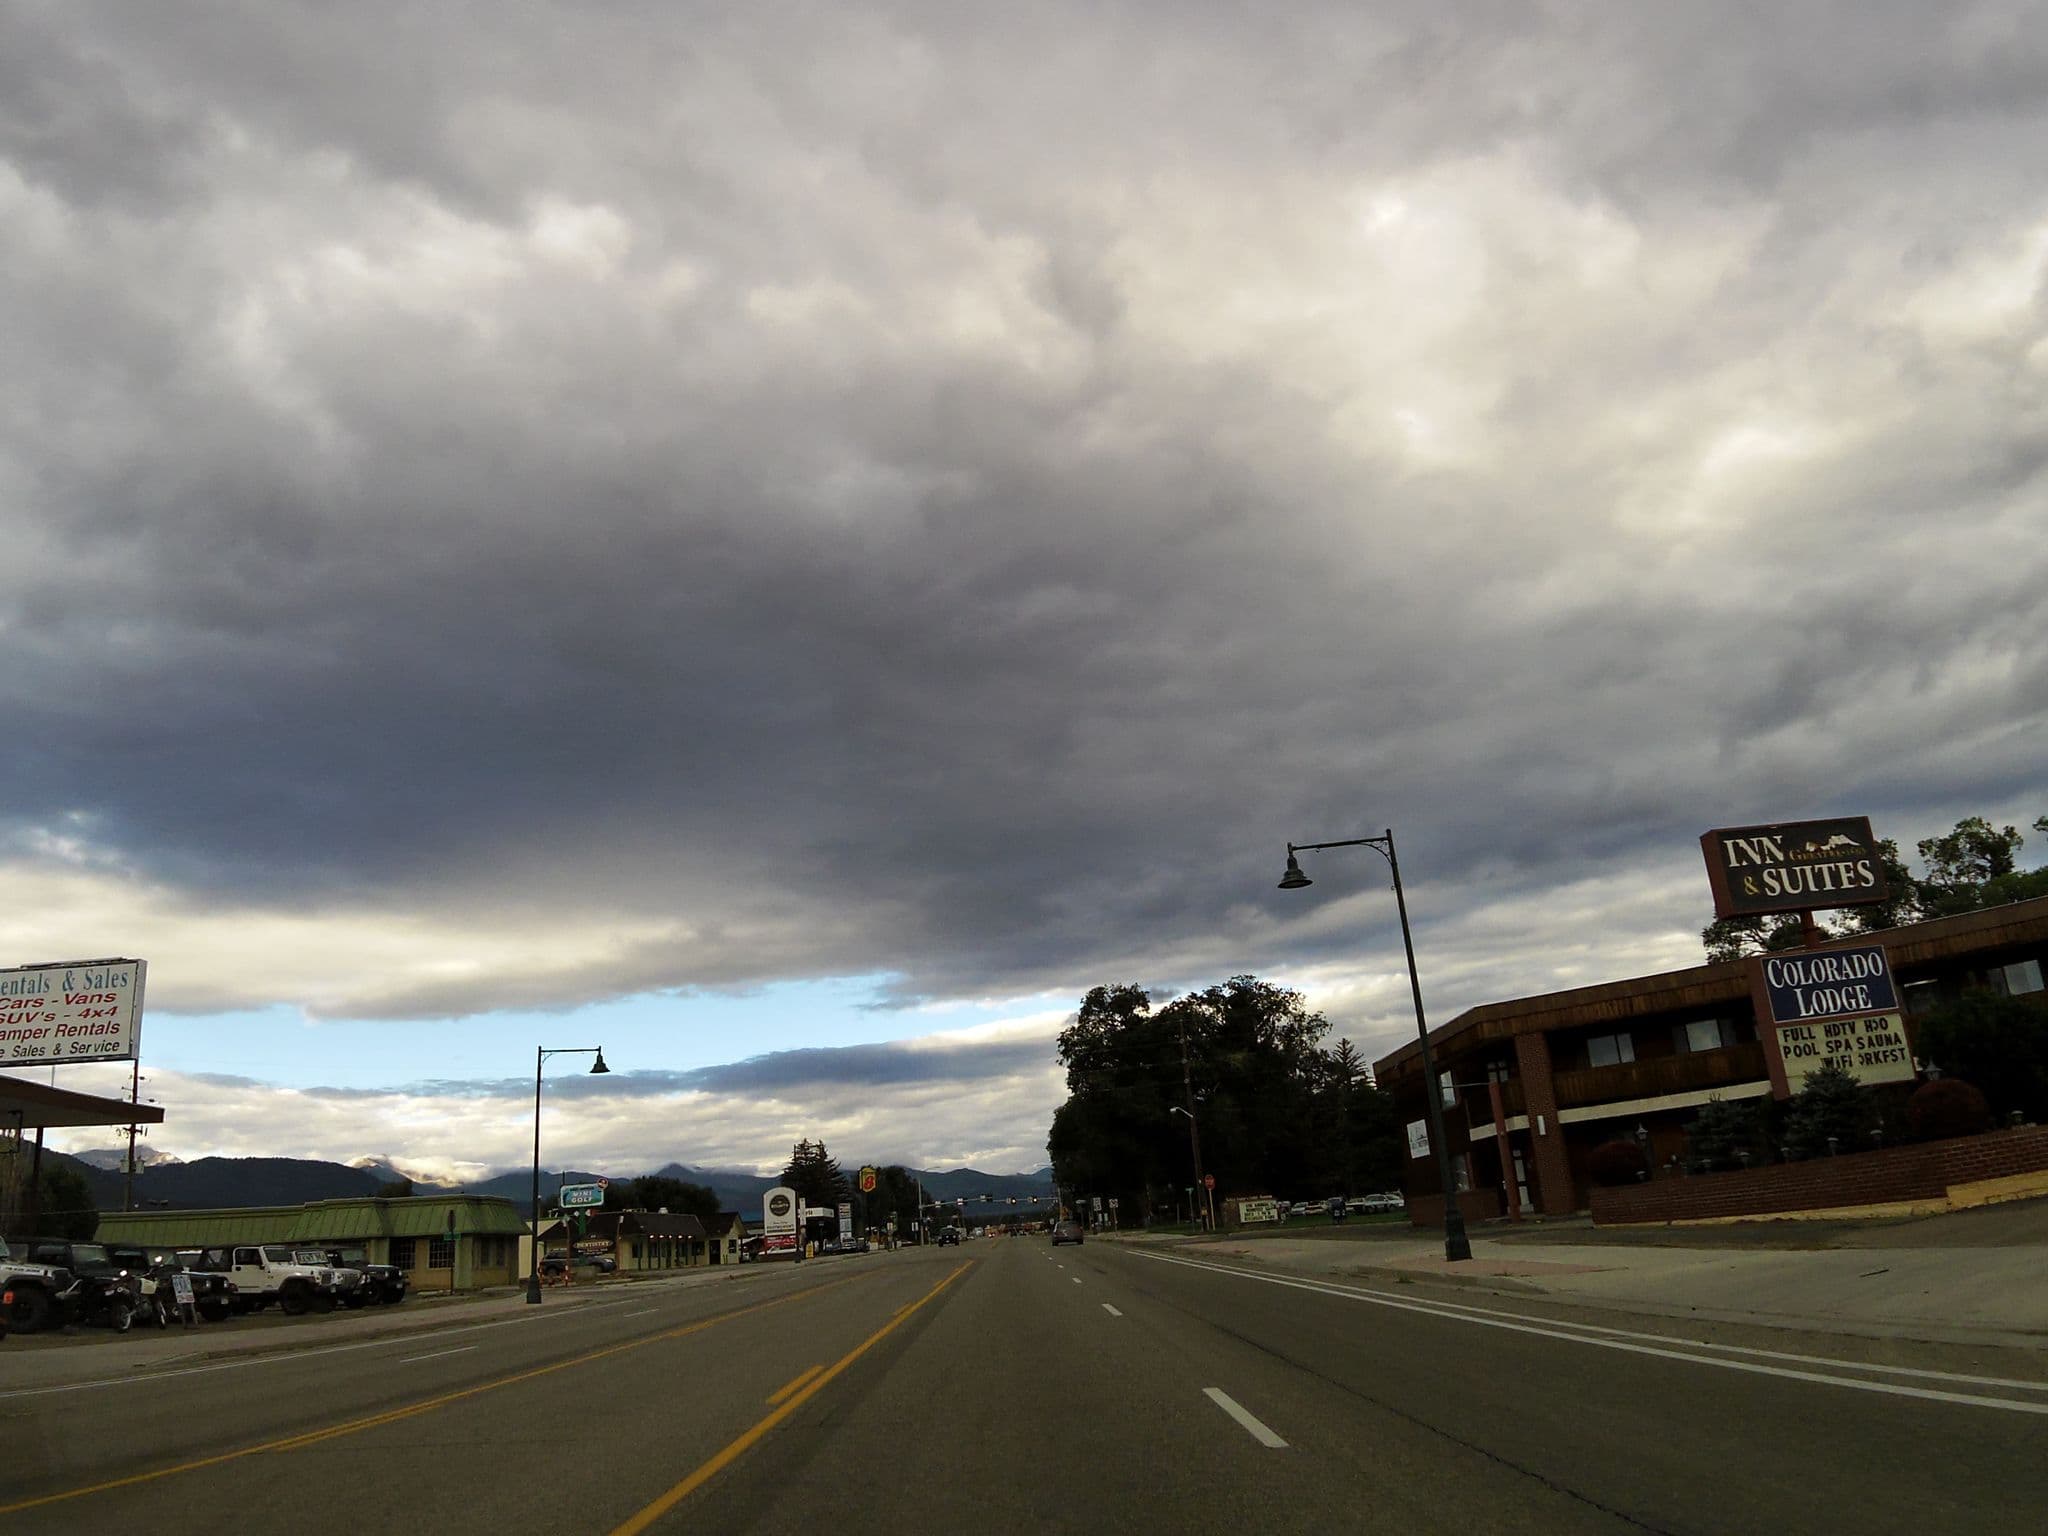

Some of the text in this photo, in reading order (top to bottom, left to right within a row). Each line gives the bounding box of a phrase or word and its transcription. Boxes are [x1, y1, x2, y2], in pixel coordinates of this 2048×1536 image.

[1723, 835, 1785, 868] INN
[1744, 859, 1875, 896] & SUITES
[62, 970, 75, 991] &
[83, 968, 128, 990] Sales
[1767, 952, 1883, 989] COLORADO
[64, 993, 117, 1005] Vans
[1794, 984, 1872, 1017] LODGE
[78, 1006, 118, 1018] 4x4
[55, 1021, 120, 1037] Rentals
[1783, 1026, 1816, 1042] FULL
[1824, 1021, 1856, 1038] HDTV
[12, 1045, 46, 1058] Sales
[53, 1043, 62, 1056] &
[70, 1040, 120, 1055] Service
[1783, 1032, 1902, 1059] POOL SPA SAUNA
